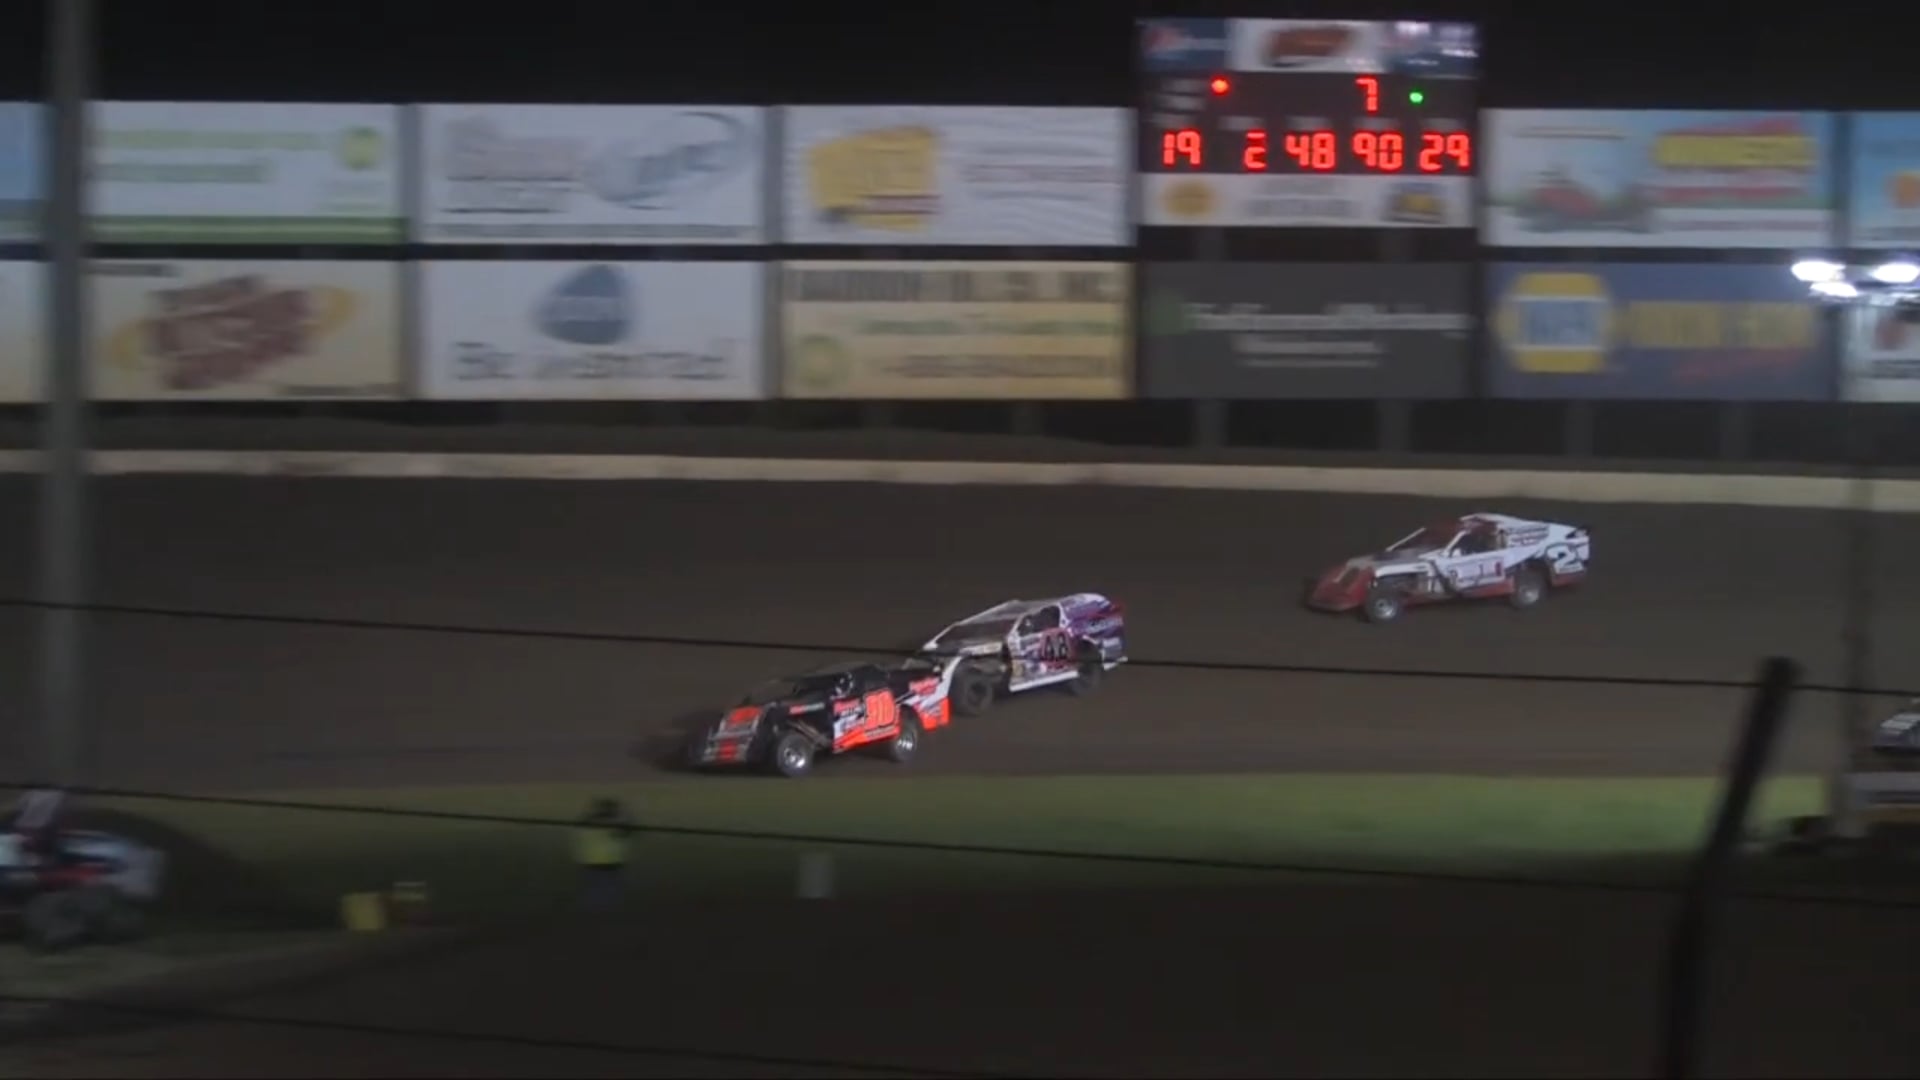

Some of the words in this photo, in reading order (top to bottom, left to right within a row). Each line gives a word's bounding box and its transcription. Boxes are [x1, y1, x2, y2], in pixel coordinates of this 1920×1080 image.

[1356, 76, 1379, 113] 7
[1163, 129, 1202, 166] 19
[1243, 130, 1267, 171] 2
[1285, 130, 1337, 171] 48
[1352, 131, 1404, 172] 90
[1419, 132, 1471, 173] 29
[865, 688, 896, 728] 90
